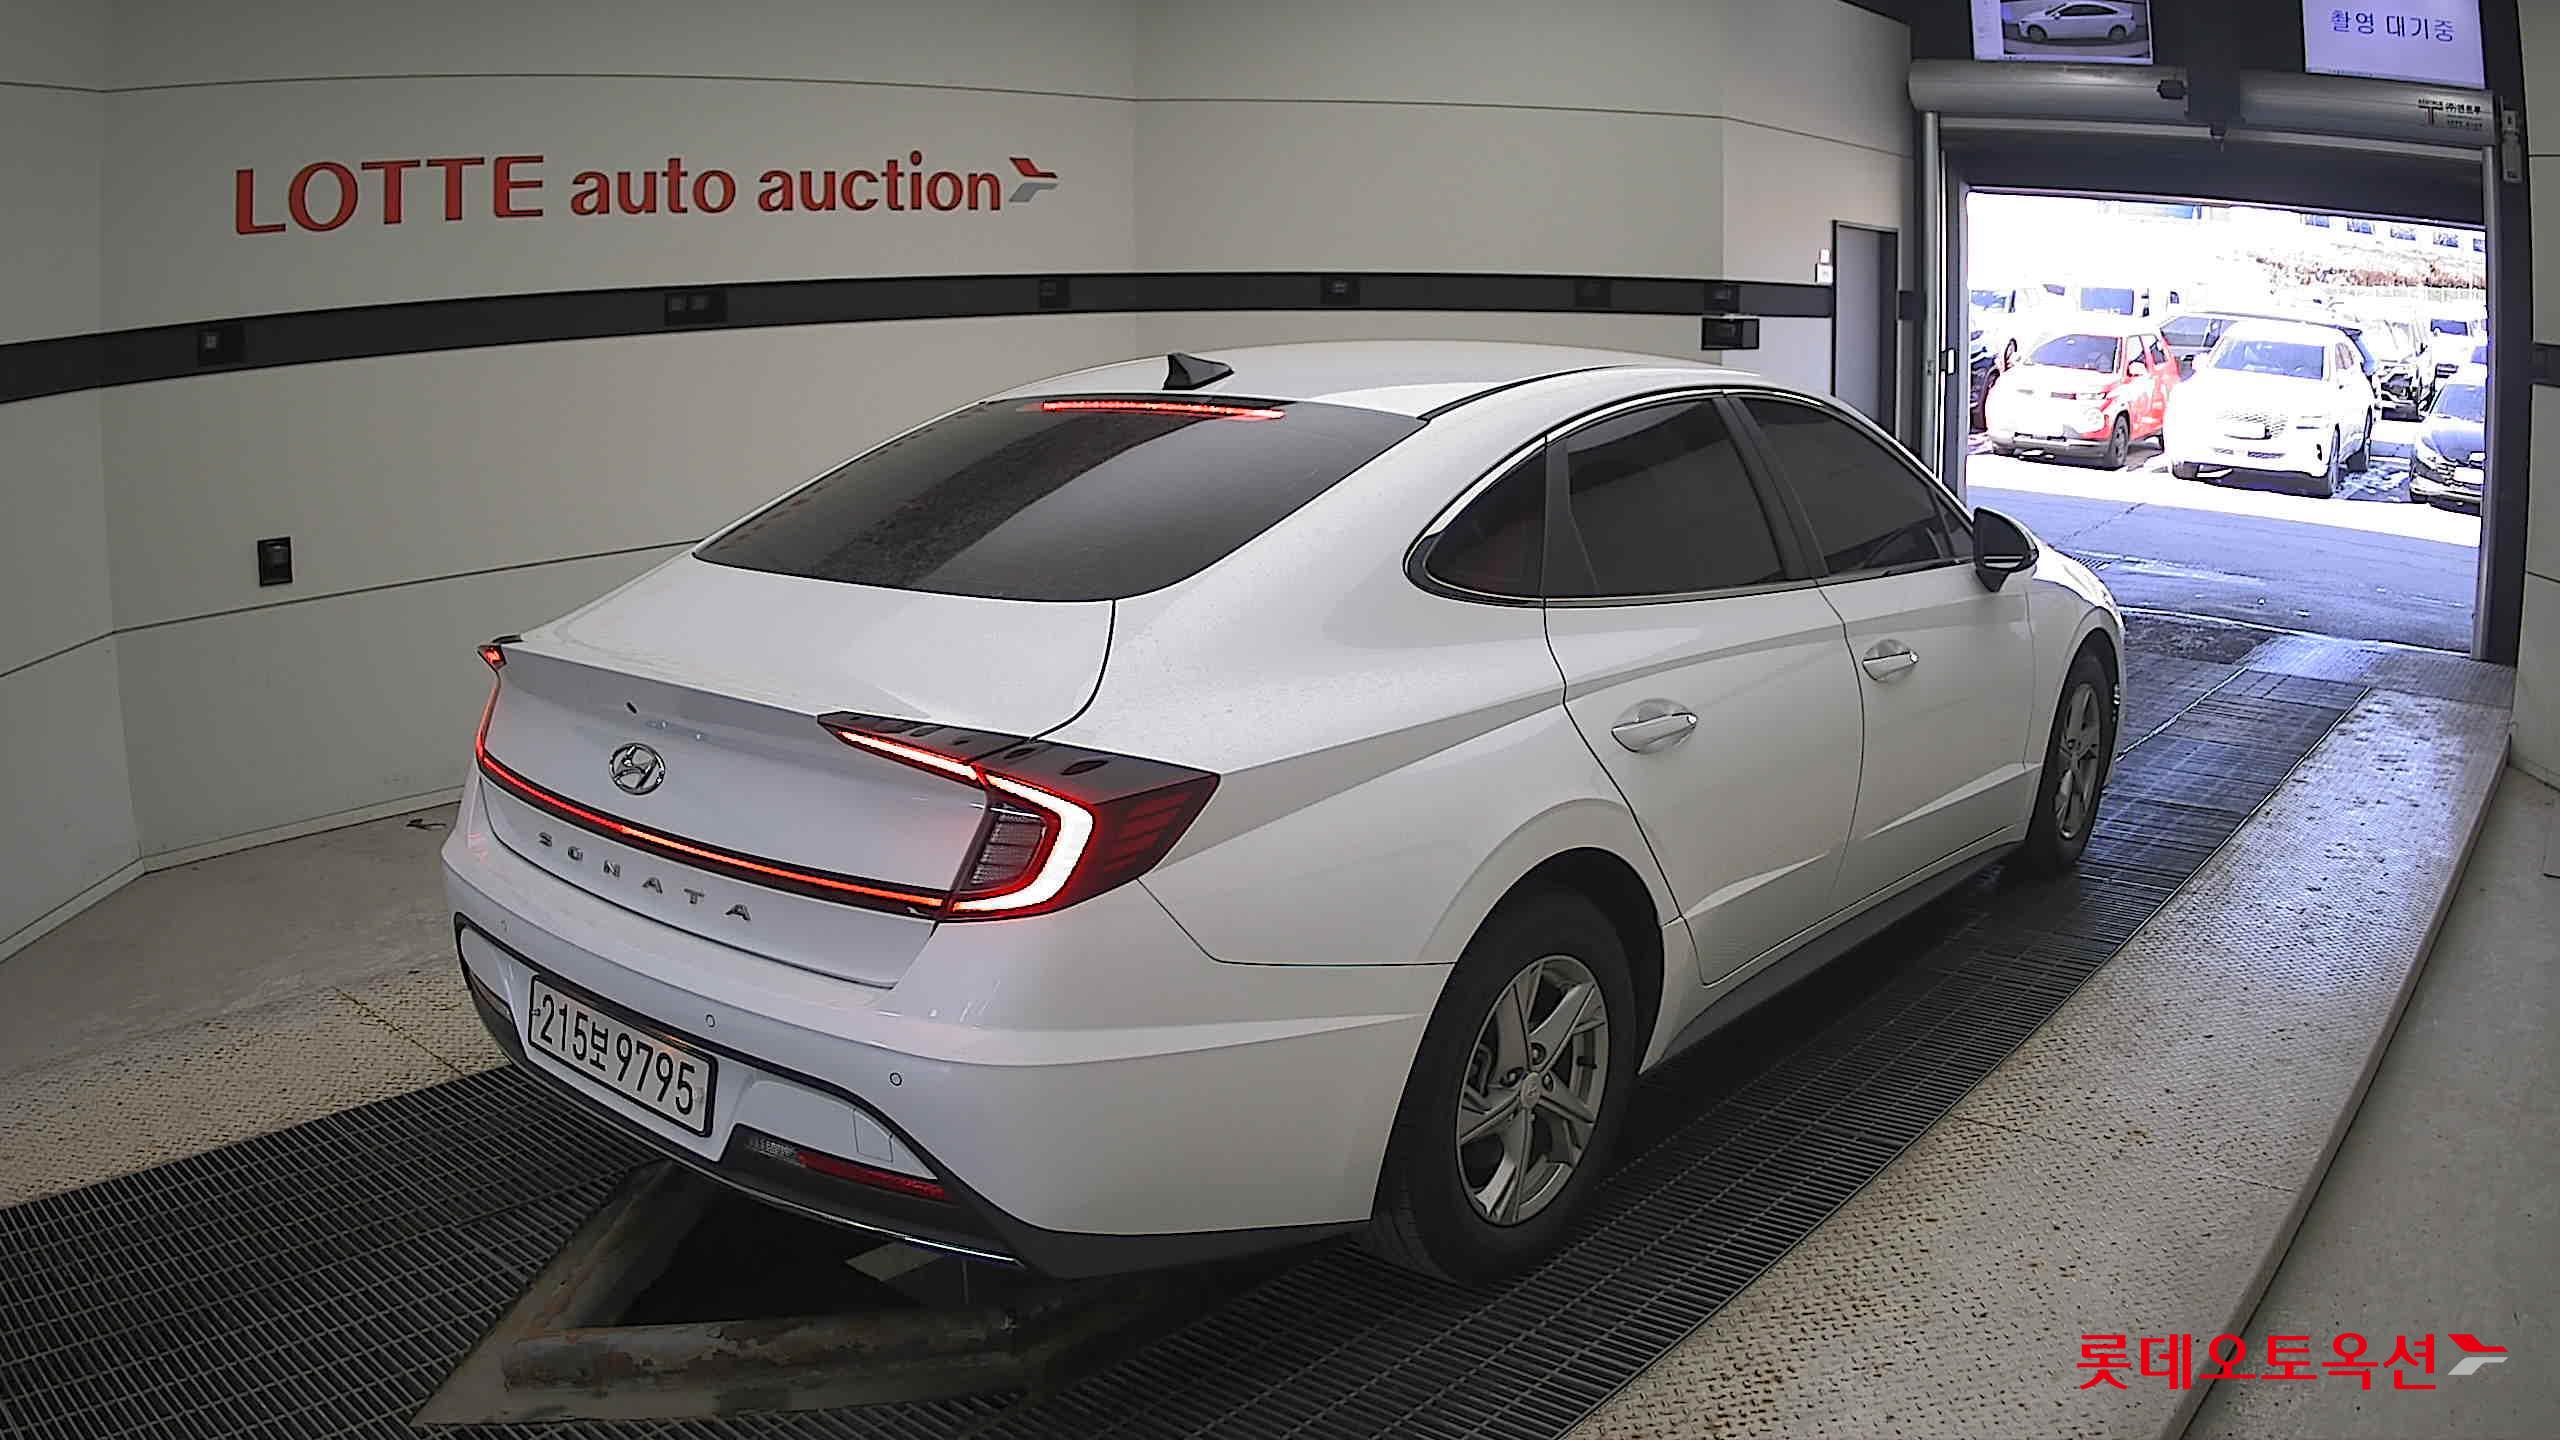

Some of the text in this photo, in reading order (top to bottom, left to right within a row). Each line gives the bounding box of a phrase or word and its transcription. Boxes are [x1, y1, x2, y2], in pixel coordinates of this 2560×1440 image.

[2331, 9, 2455, 43] 촬영 대기중
[235, 151, 1003, 235] LOTTE auto auction
[538, 831, 751, 922] SONATA
